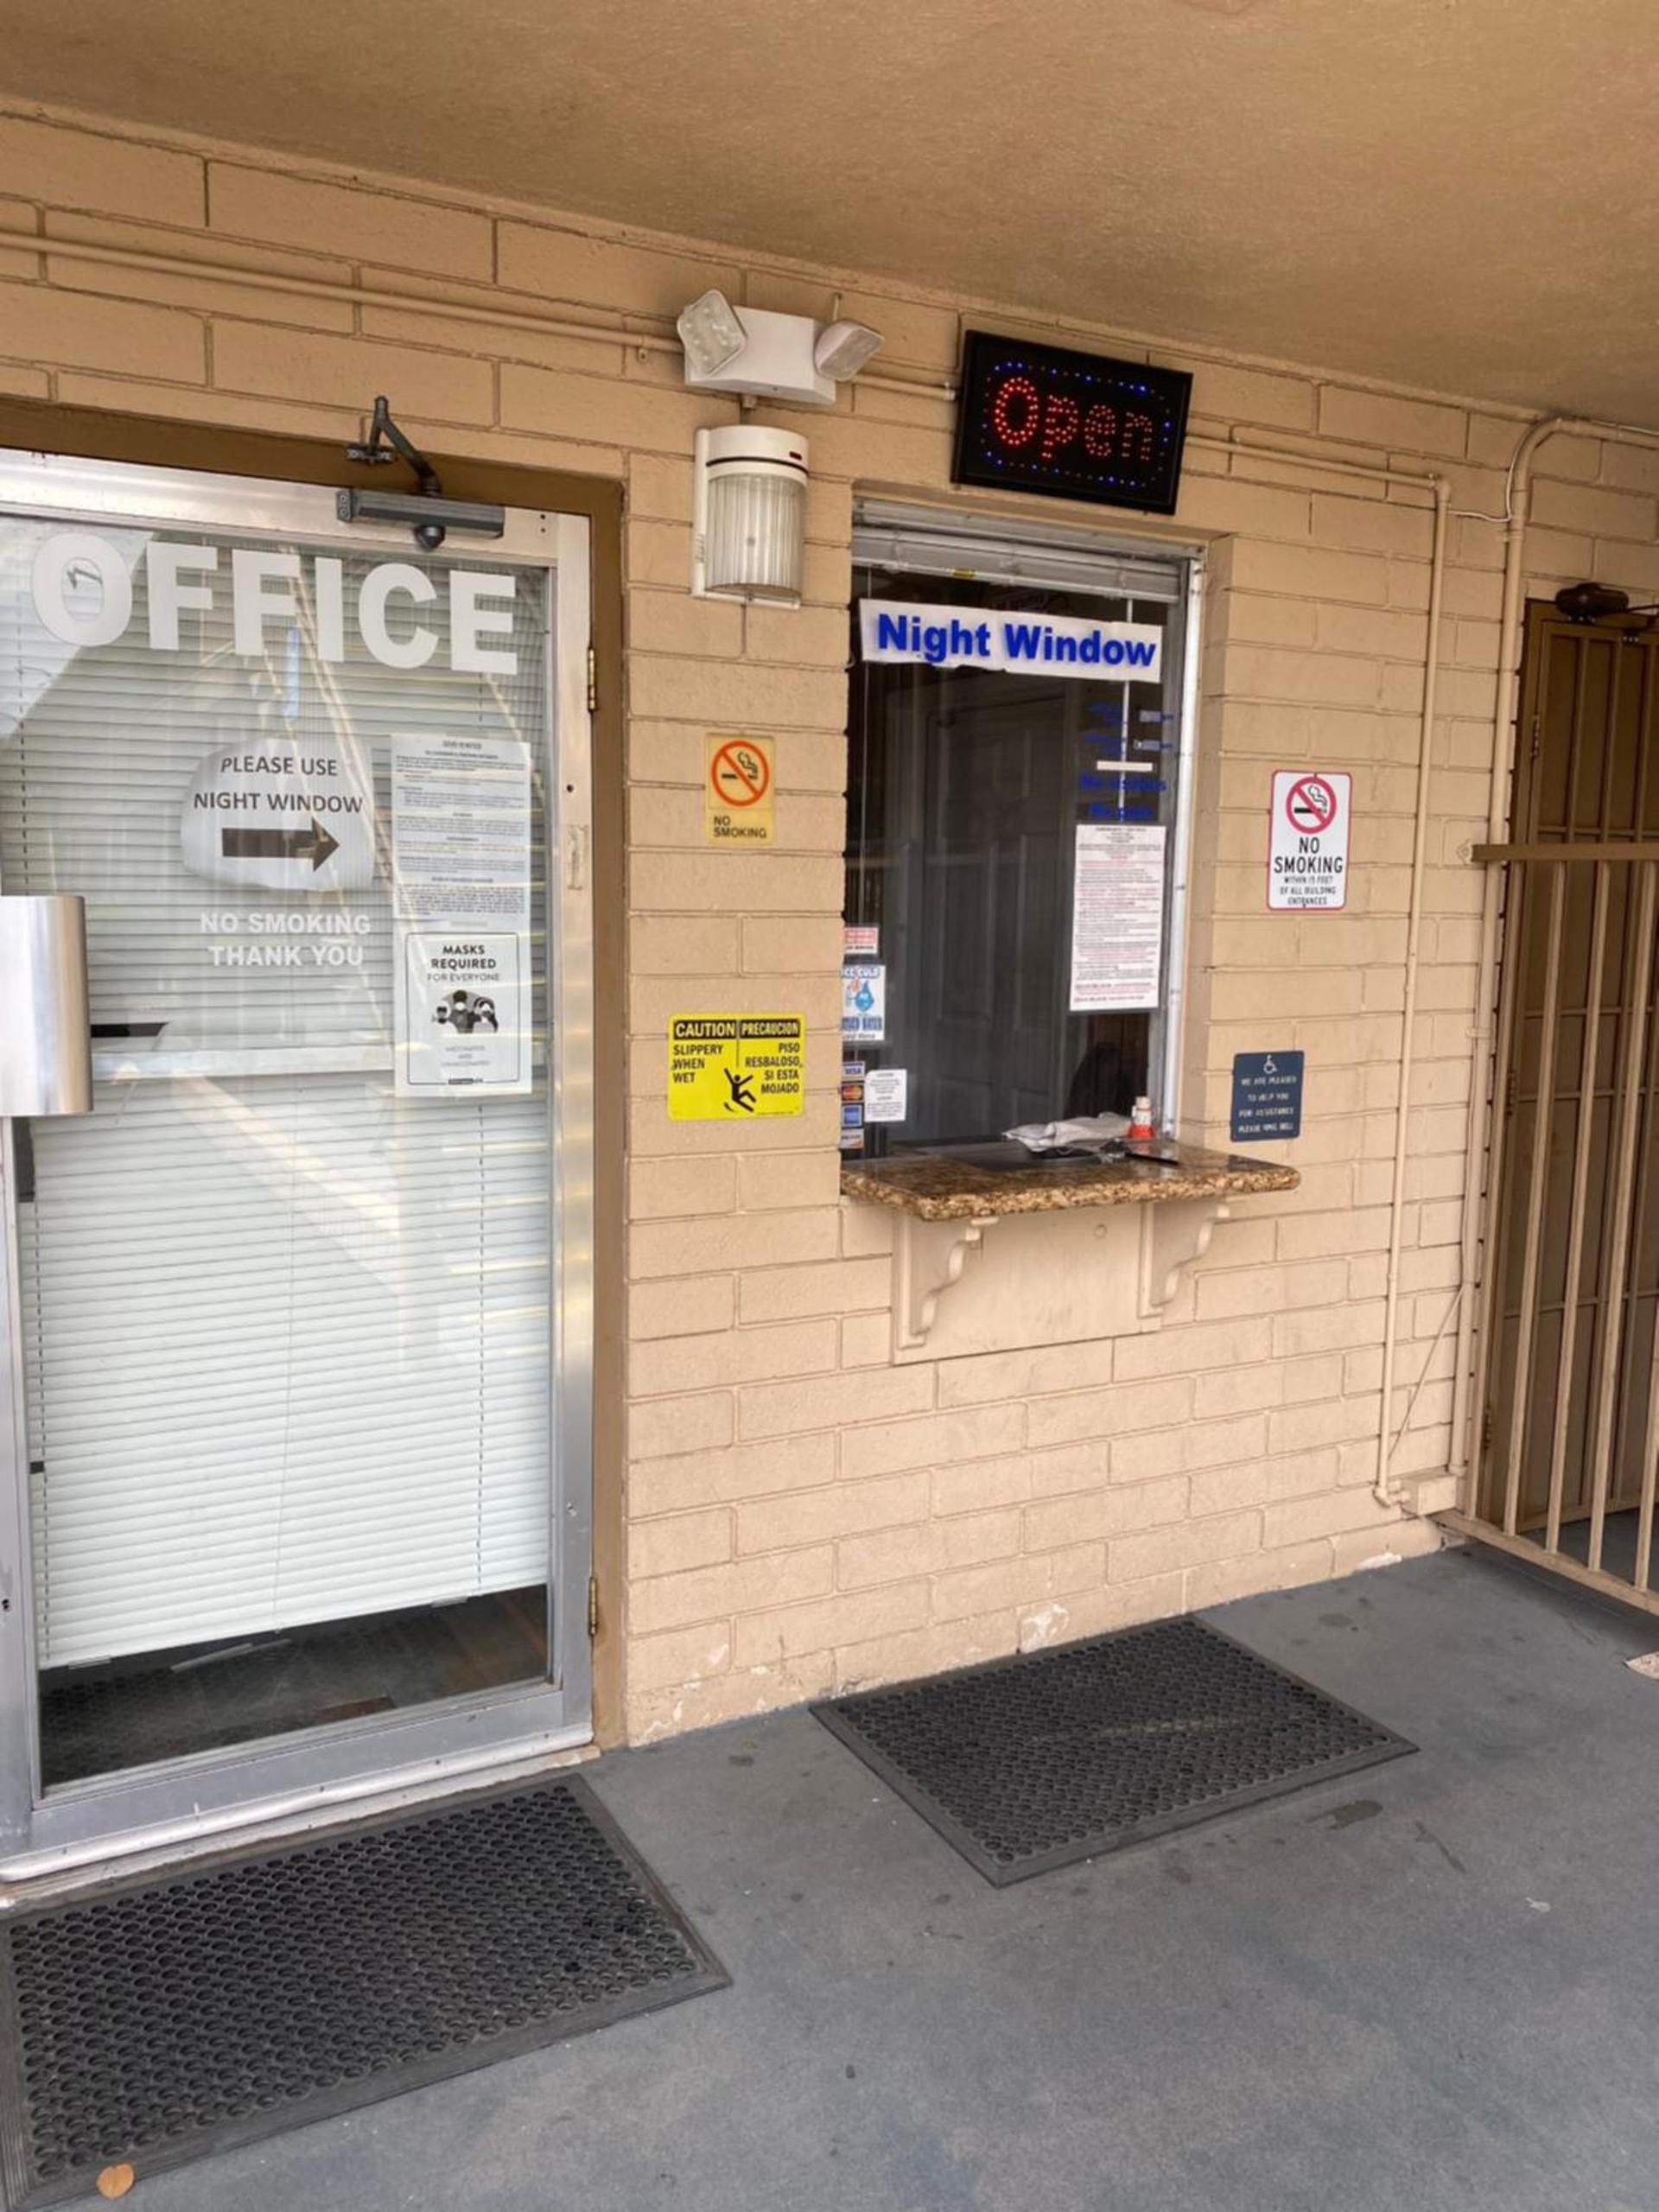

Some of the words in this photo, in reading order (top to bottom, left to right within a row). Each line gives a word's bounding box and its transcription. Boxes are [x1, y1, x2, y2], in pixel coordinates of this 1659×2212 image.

[994, 377, 1154, 460] Open
[31, 532, 518, 675] OFFICE
[877, 613, 990, 663] Night
[1004, 623, 1156, 667] Window
[220, 756, 295, 775] PLEASE
[302, 758, 338, 776] USE
[194, 791, 261, 810] NIGHT
[267, 793, 363, 813] WINDOW
[714, 815, 731, 827] NO
[714, 826, 767, 839] SMOKING
[1299, 836, 1320, 855] NO
[1274, 856, 1343, 874] SMOKING
[1290, 887, 1302, 895] ALL
[1304, 886, 1336, 895] BUILDING
[1287, 896, 1327, 906] ENTRANCES
[200, 912, 238, 933] NO
[248, 912, 372, 935] SMOKING
[207, 945, 302, 967] THANK
[312, 946, 364, 967] YOU
[442, 944, 486, 955] MASKS
[431, 957, 497, 969] REQUIRED
[426, 972, 448, 982] FOR
[449, 972, 500, 982] EVERYONE
[675, 1021, 734, 1037] CAUTION
[672, 1043, 724, 1056] SLIPPERY
[778, 1042, 800, 1053] PISO
[672, 1058, 705, 1070] WHEN
[673, 1071, 696, 1083] WET
[764, 1070, 774, 1080] SI
[777, 1069, 799, 1080] ESTA
[760, 1083, 800, 1094] MOJADO
